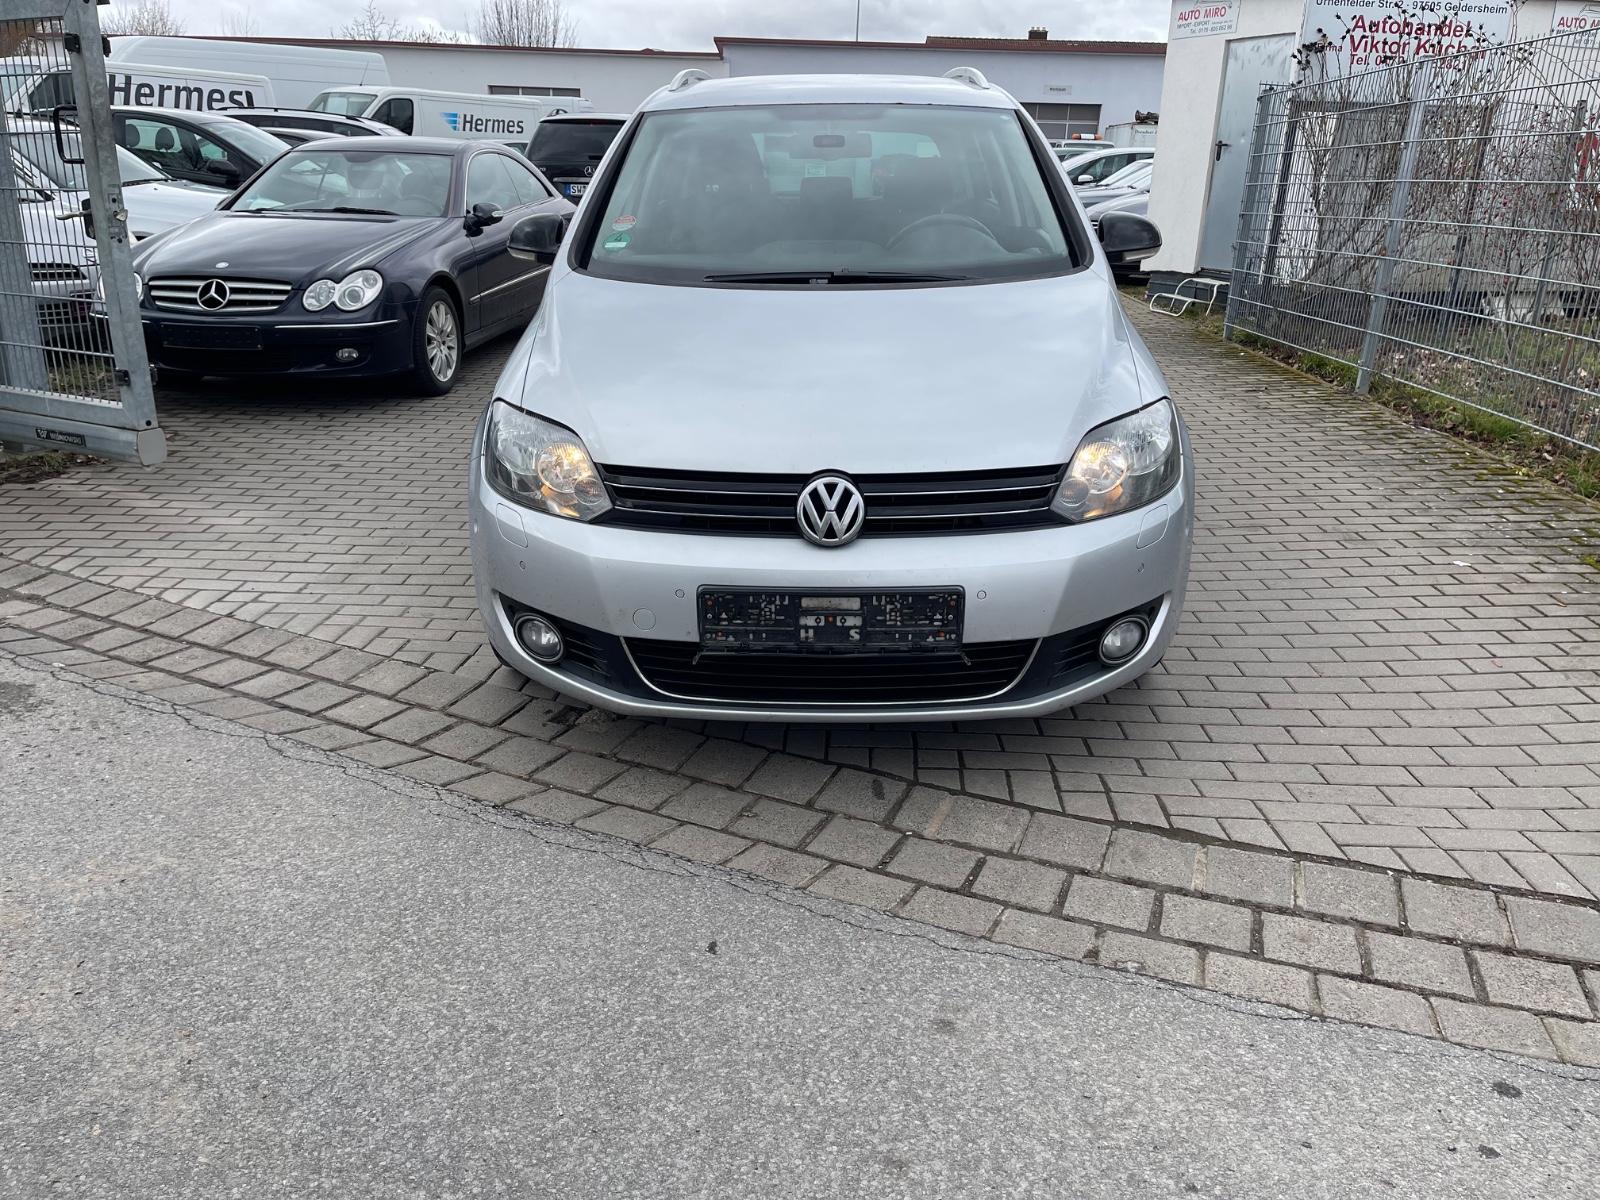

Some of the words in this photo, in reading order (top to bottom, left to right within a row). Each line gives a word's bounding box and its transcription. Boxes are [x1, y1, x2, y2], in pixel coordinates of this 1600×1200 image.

[1178, 9, 1200, 22] AUTO
[1204, 6, 1227, 19] MIRO
[1412, 1, 1441, 10] 97505
[1444, 2, 1507, 14] Geldersheim
[1351, 15, 1472, 38] Autohandel
[1557, 16, 1587, 29] AUTO
[1350, 35, 1410, 56] Viktor
[109, 73, 245, 112] Hermes
[462, 113, 524, 134] Hermes
